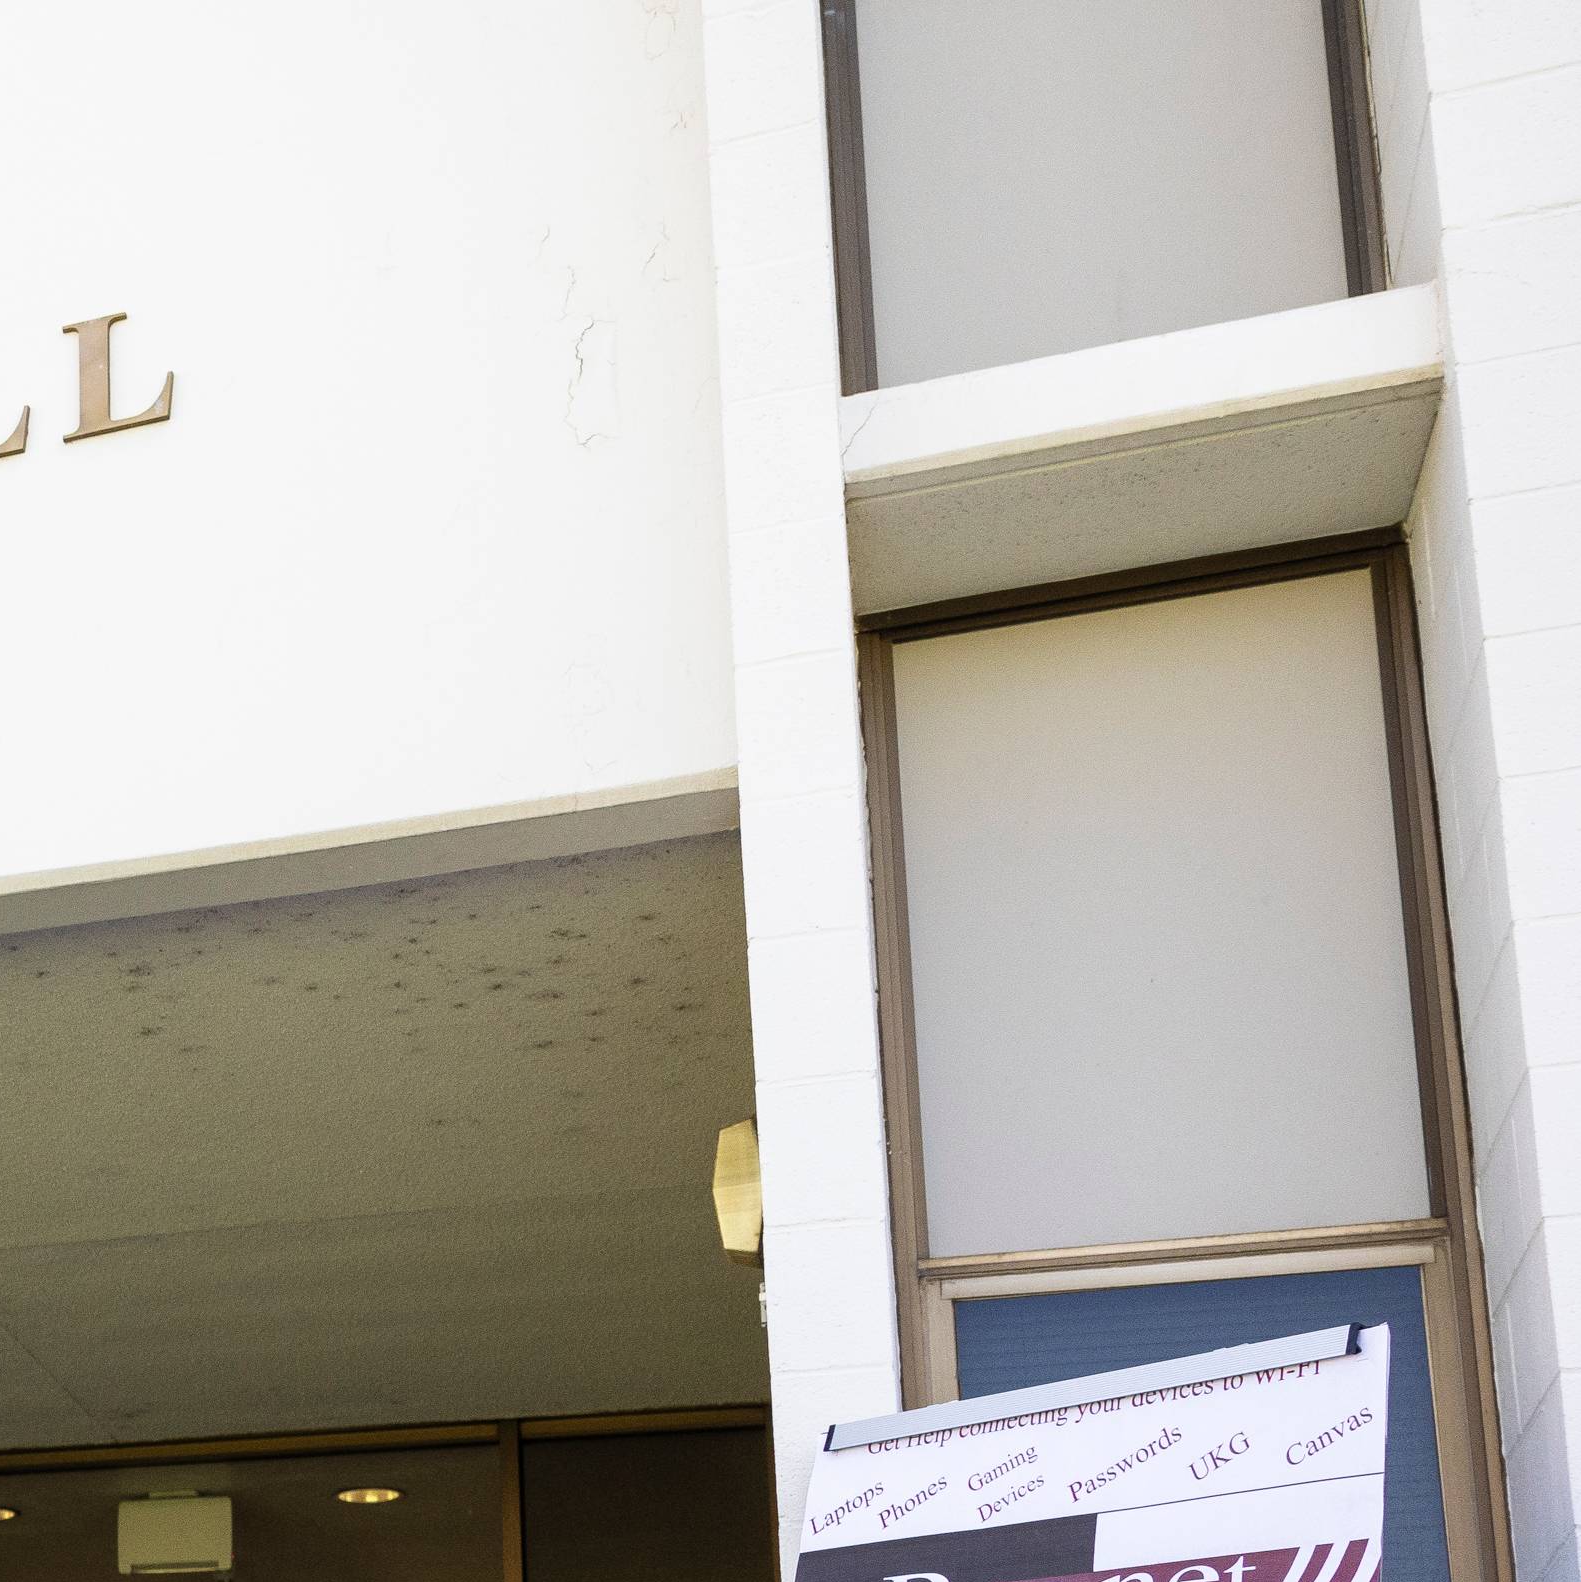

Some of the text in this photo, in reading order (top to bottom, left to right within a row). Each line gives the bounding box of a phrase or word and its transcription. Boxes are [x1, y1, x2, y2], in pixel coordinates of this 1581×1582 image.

[959, 1407, 1069, 1438] connecting
[1075, 1395, 1126, 1423] your
[1132, 1379, 1214, 1407] devices
[1223, 1374, 1244, 1391] to
[1067, 1424, 1183, 1503] Passwords
[1187, 1431, 1251, 1481] UKG
[1285, 1405, 1373, 1467] Canvas
[967, 1445, 1039, 1492] Gaming
[809, 1481, 884, 1536] Laptops
[877, 1475, 948, 1530] Phones
[977, 1475, 1045, 1523] Devices
